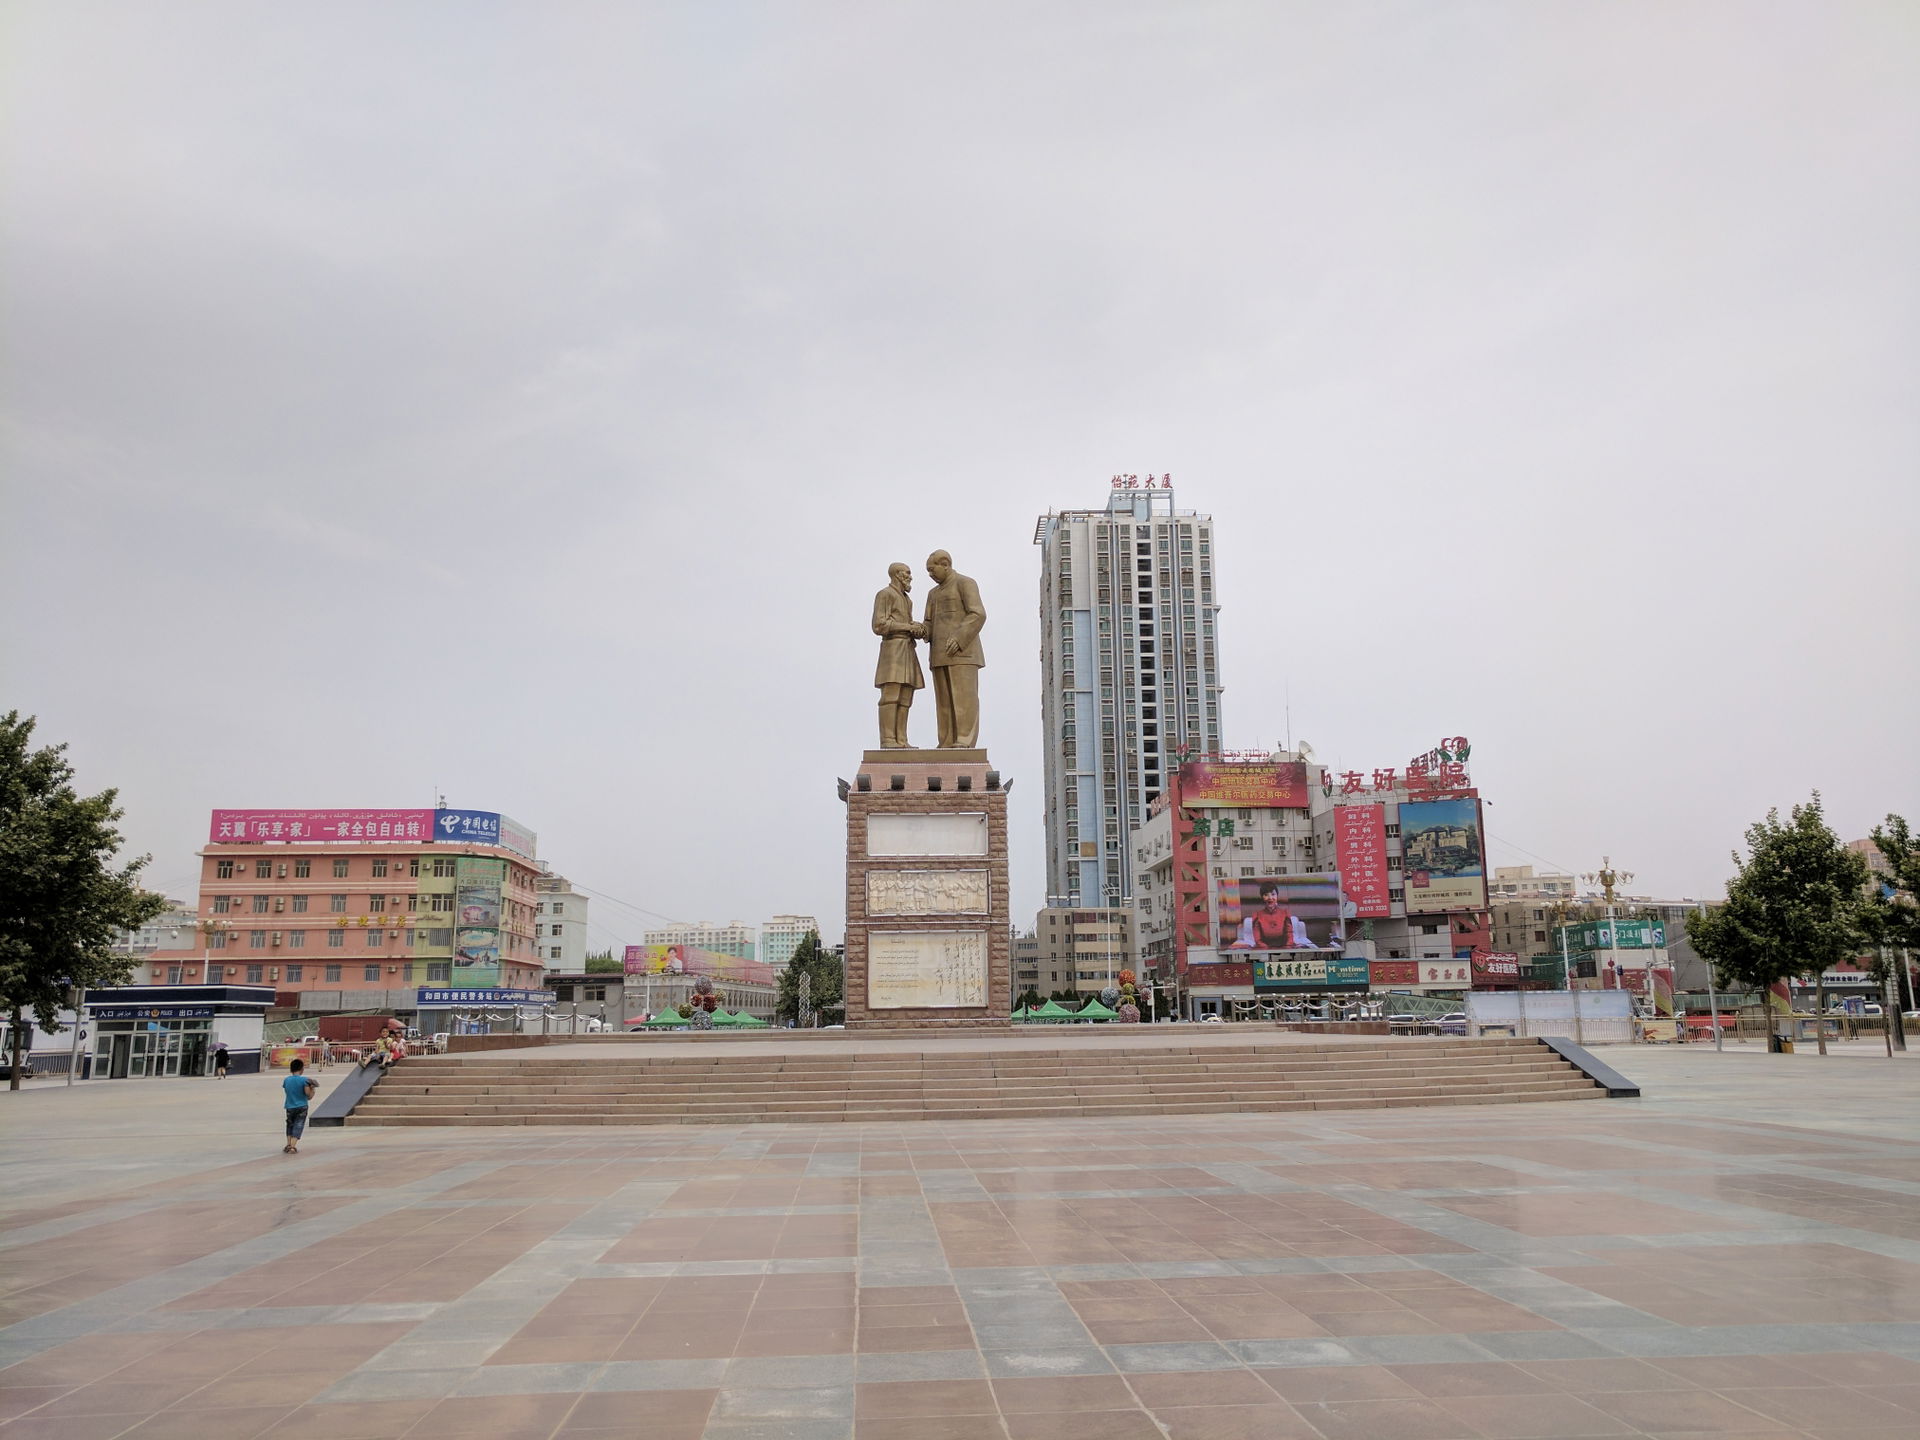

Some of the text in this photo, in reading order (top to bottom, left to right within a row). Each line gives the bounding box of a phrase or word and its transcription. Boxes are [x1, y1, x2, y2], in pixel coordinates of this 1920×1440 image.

[1341, 762, 1467, 794] 友好医院
[462, 816, 497, 832] 中国电信
[1487, 963, 1518, 974] 友好医院
[178, 1009, 193, 1017] 出口
